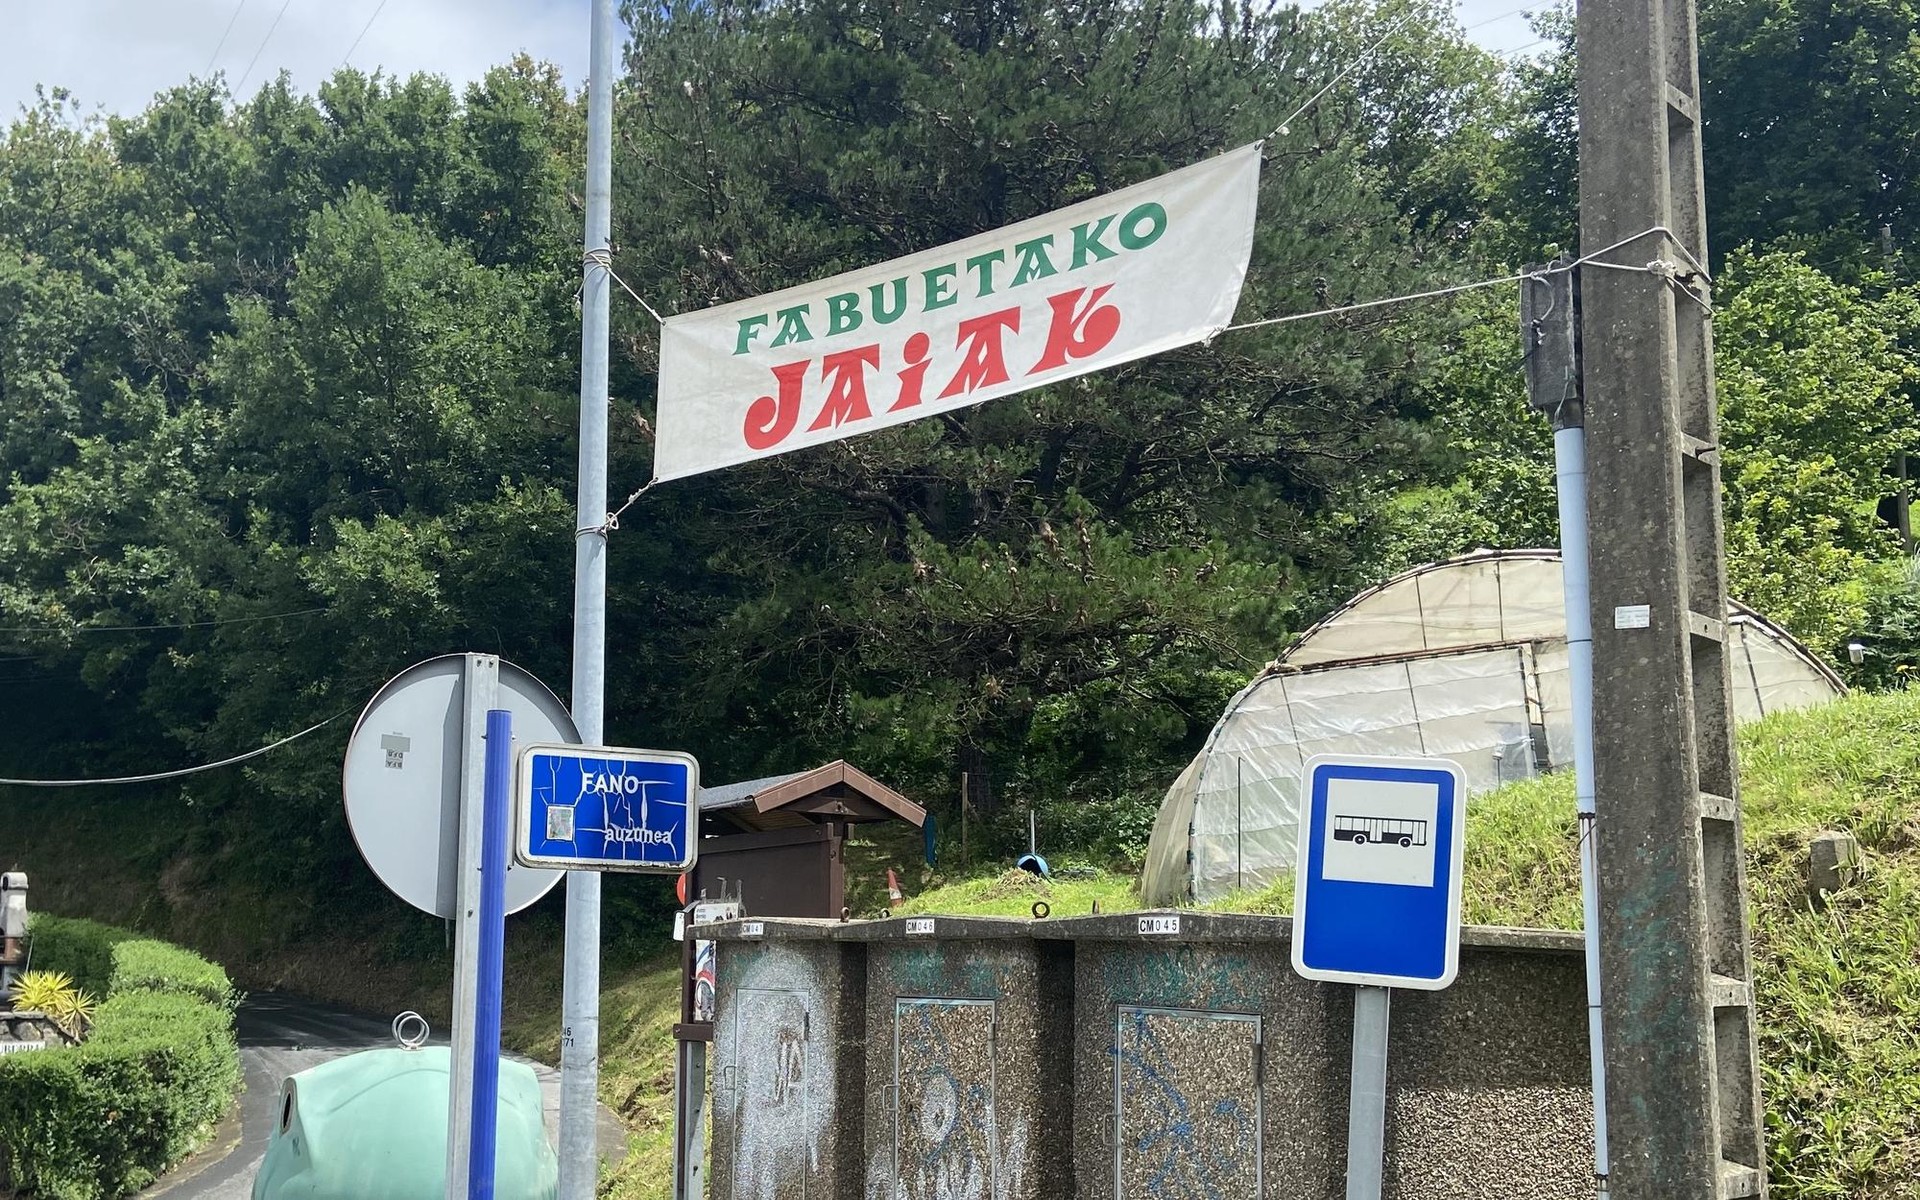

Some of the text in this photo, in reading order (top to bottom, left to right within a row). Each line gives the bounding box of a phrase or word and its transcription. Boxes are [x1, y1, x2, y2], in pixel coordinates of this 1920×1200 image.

[733, 202, 1167, 355] FABUETAKO
[582, 772, 639, 794] FANO
[605, 827, 672, 844] auzunea
